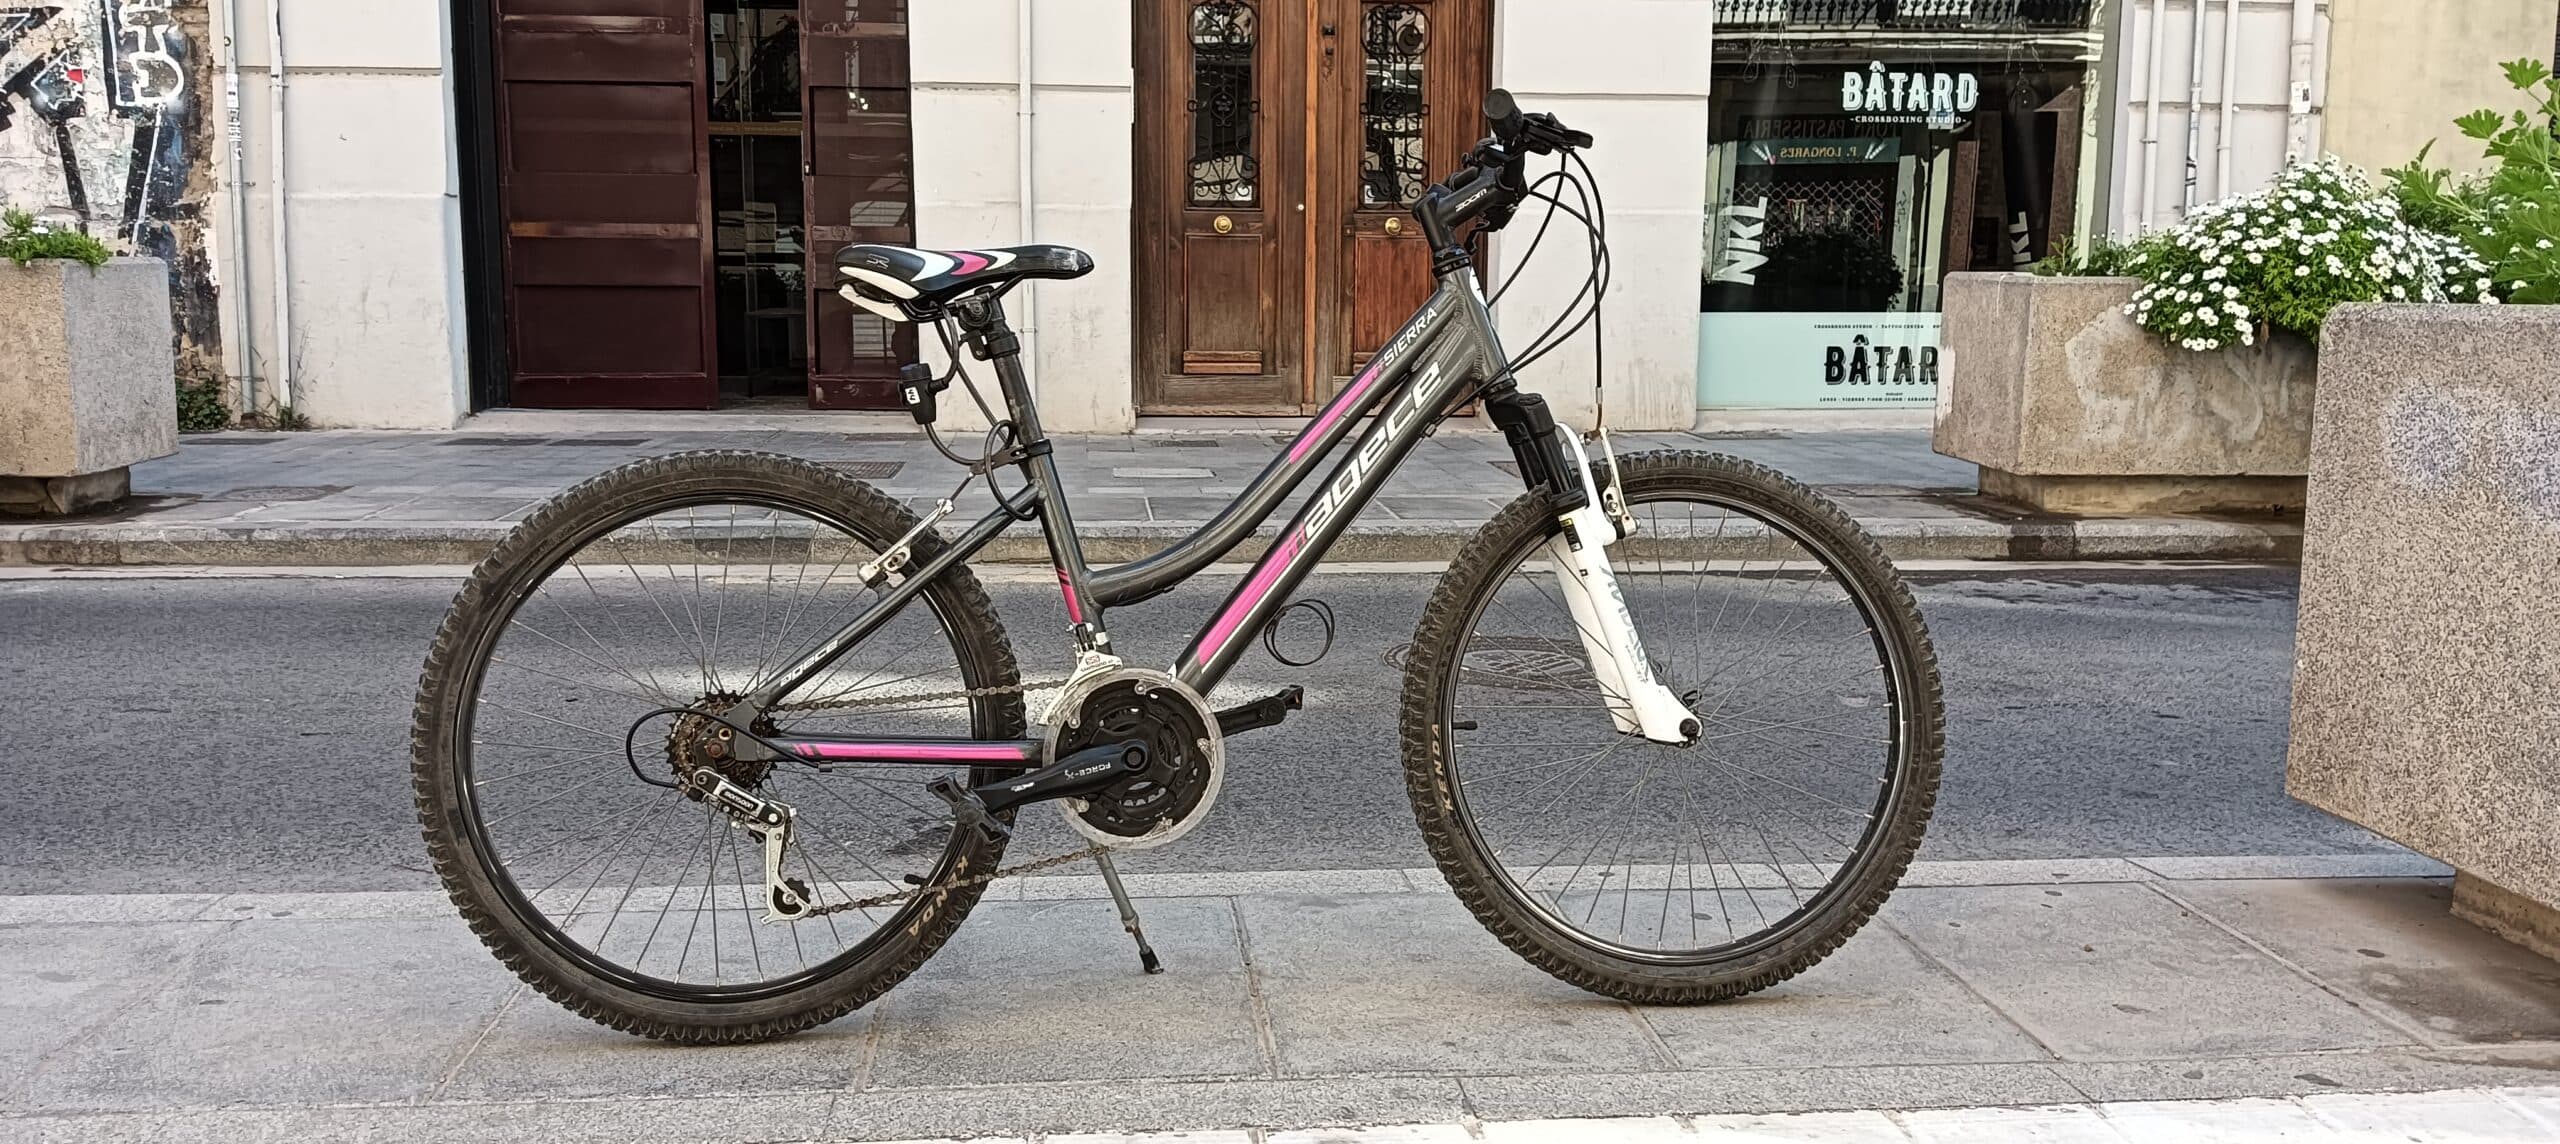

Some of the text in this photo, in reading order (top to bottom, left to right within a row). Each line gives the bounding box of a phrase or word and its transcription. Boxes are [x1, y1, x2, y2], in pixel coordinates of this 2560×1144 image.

[1841, 61, 1980, 112] BÂTARD
[1384, 308, 1437, 366] SIERRA
[1824, 334, 1938, 385] BÂTAR
[1431, 724, 1454, 811] KENDA
